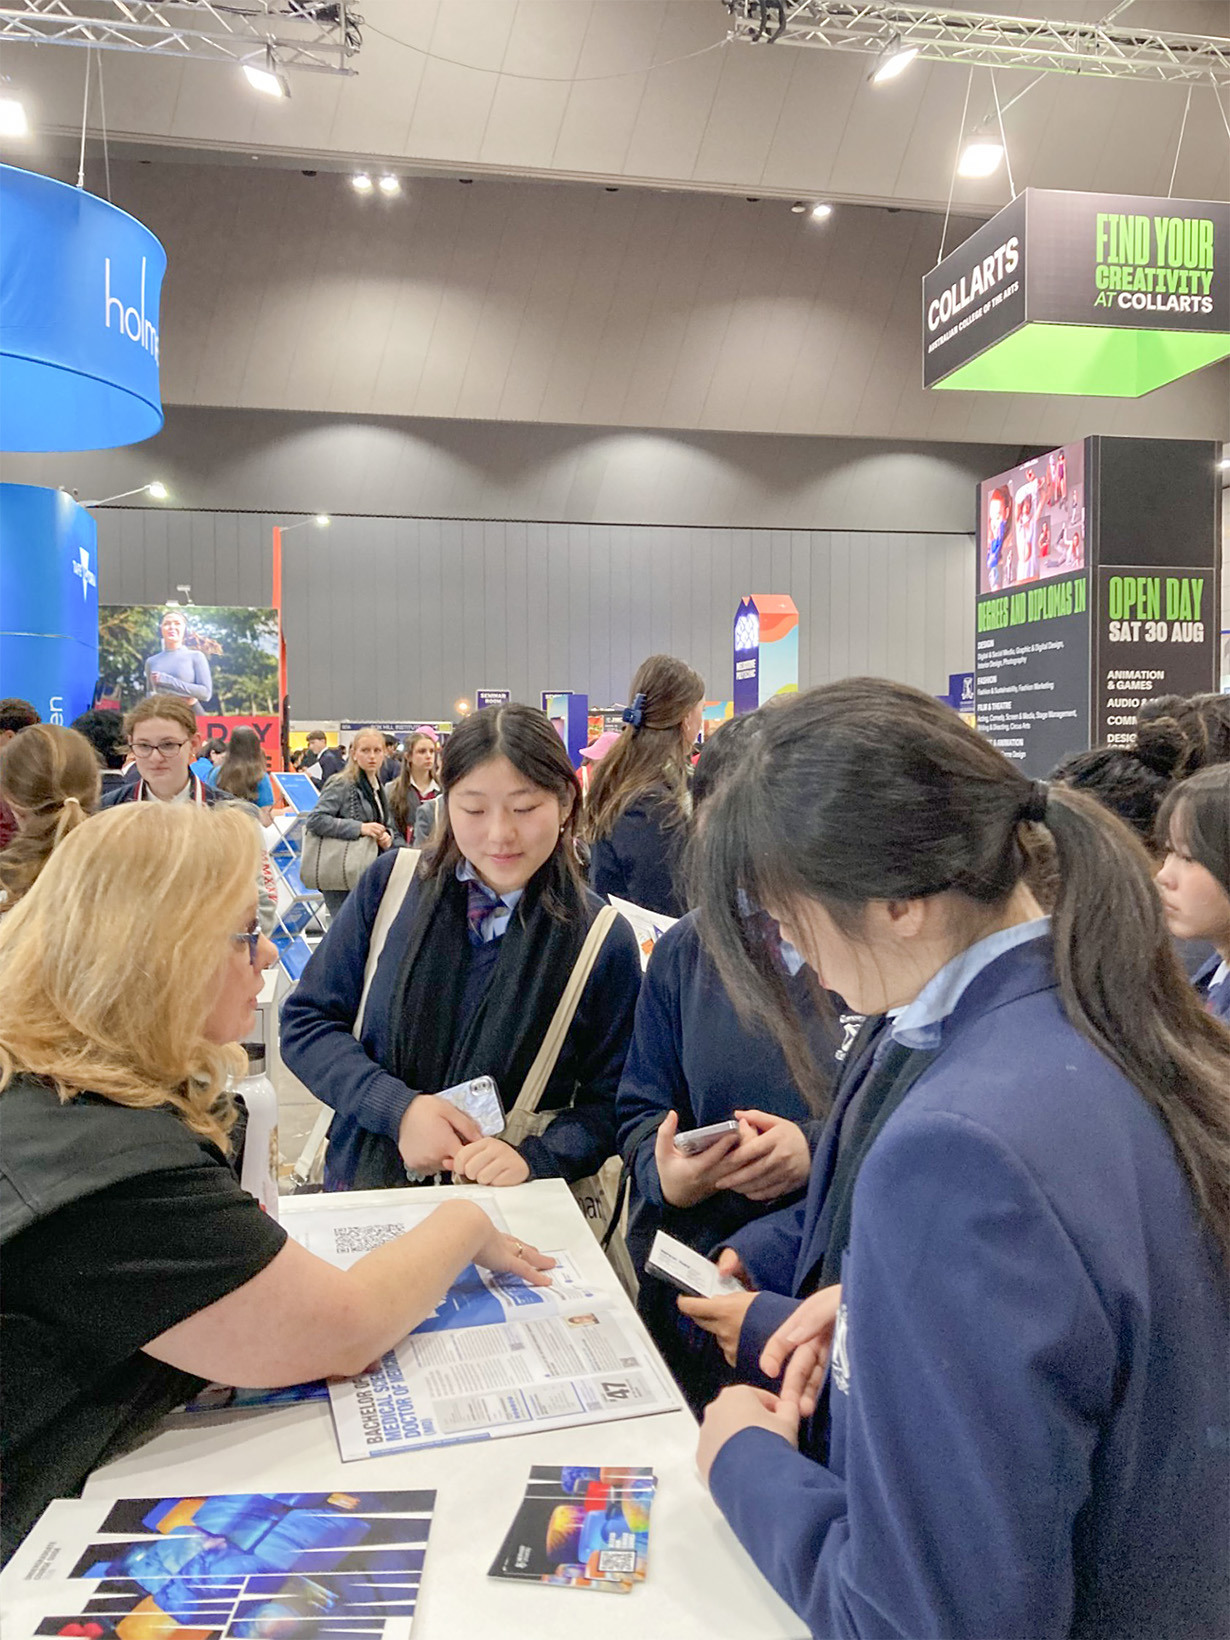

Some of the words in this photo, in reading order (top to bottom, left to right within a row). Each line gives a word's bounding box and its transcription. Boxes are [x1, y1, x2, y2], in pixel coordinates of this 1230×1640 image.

[1096, 213, 1150, 265] FIND
[1154, 216, 1214, 269] YOUR
[928, 236, 1019, 331] COLLARTS
[1095, 265, 1214, 295] CREATIVITY
[1094, 291, 1117, 308] AT
[1117, 292, 1214, 313] COLLARTS
[928, 325, 958, 354] AUSTRALIAN
[959, 307, 983, 331] COLLEGE
[983, 301, 991, 314] OF
[991, 292, 1003, 308] THE
[1003, 281, 1019, 300] ARTS
[978, 596, 1009, 633] DEGREES
[1010, 592, 1027, 626] AND
[1028, 581, 1073, 622] DIPLOMAS
[1074, 578, 1086, 613] IN
[1109, 576, 1160, 620] OPEN
[1166, 577, 1204, 621] DAY
[1109, 621, 1142, 642] SAT
[1144, 621, 1168, 642] 30
[1171, 622, 1204, 643] AUG
[1107, 670, 1165, 679] ANIMATION
[1107, 681, 1115, 690] &
[1116, 681, 1153, 690] GAMES
[1107, 698, 1140, 708] AUDIO
[206, 723, 273, 742] DY
[1107, 716, 1138, 725] COMM
[1107, 733, 1137, 743] DESIG
[369, 1368, 390, 1393] SCIEN
[392, 1384, 409, 1396] OF
[356, 1390, 383, 1444] BACHELOR
[376, 1394, 402, 1442] MEDICAL
[396, 1397, 421, 1439] DOCTOR
